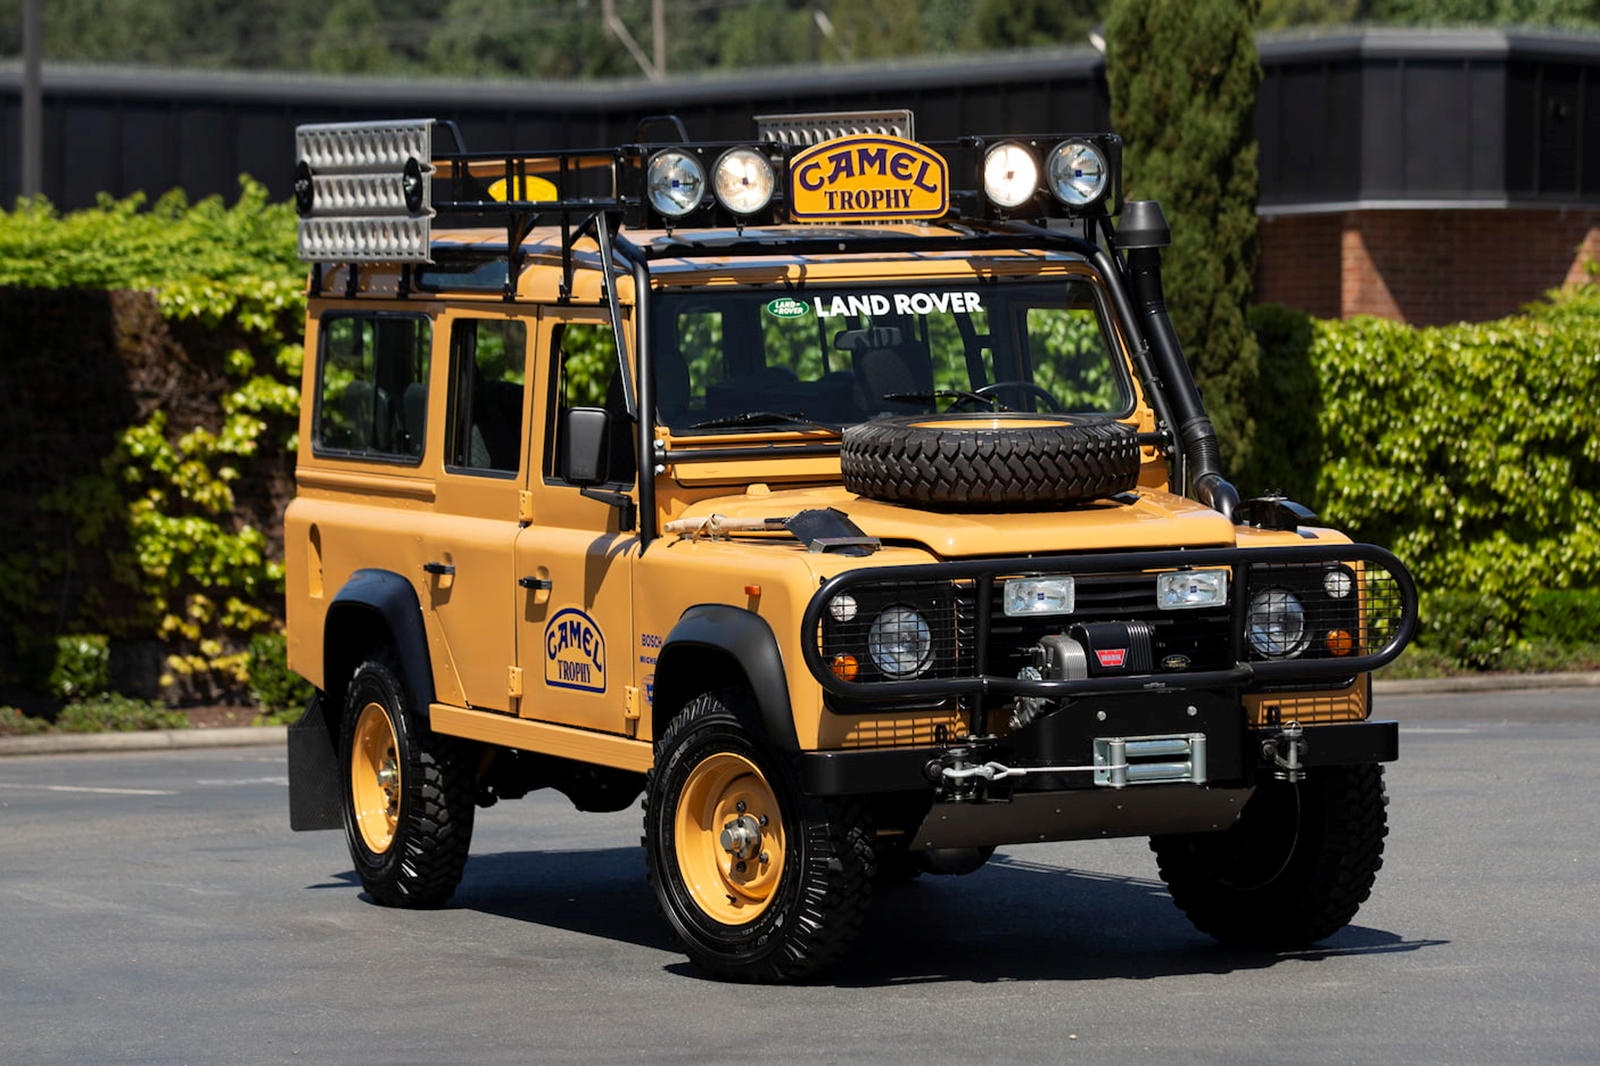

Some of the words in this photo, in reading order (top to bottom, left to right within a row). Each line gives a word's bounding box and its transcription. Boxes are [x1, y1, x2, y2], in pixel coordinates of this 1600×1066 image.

[799, 147, 938, 193] CAMEL
[823, 188, 914, 210] TROPHY
[814, 295, 891, 318] LAND
[893, 292, 983, 315] ROVER
[547, 620, 602, 672] CAMEL
[641, 633, 663, 648] BOSCH
[557, 659, 591, 683] TROPHY
